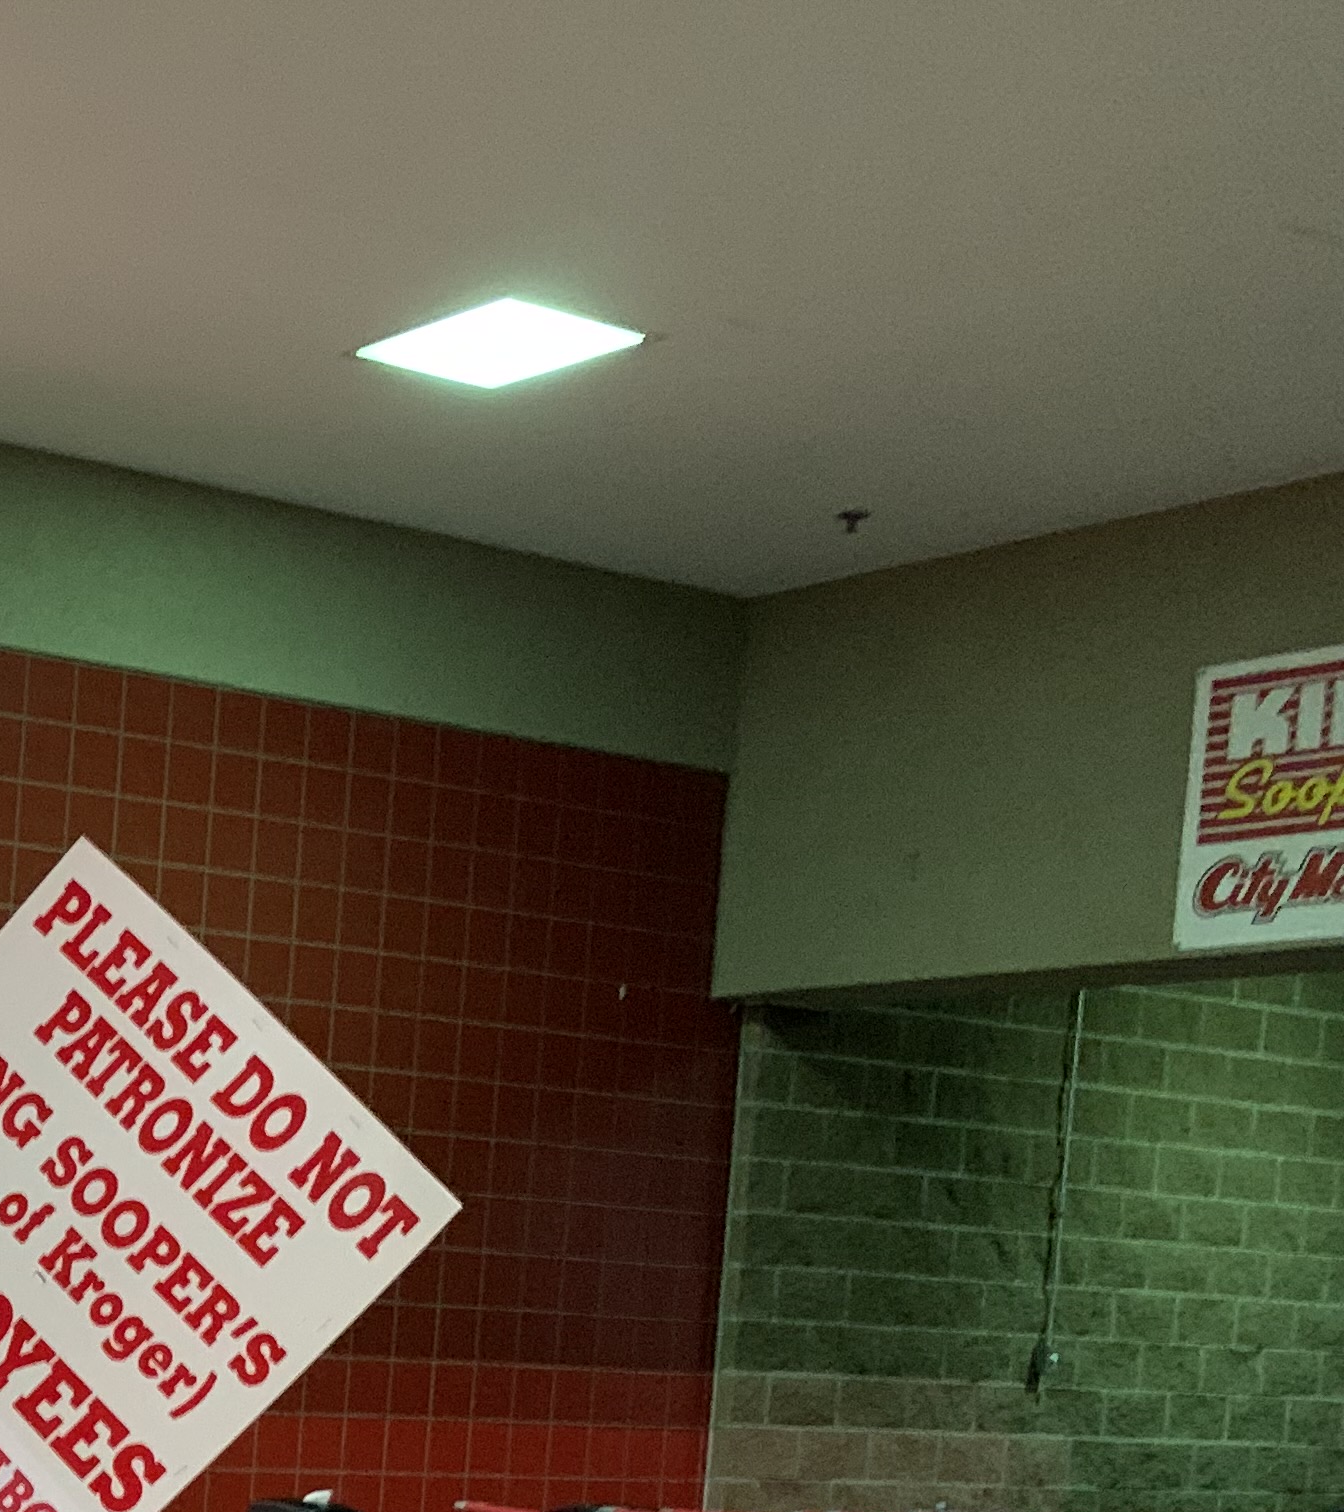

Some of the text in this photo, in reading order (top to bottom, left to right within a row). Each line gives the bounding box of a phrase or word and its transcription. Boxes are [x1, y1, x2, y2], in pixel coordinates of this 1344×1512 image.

[1196, 853, 1291, 921] City
[32, 879, 420, 1259] PLEASE DO NOT
[33, 988, 305, 1267] PATRONIZE
[38, 1226, 217, 1419] Kroger)
[39, 1135, 286, 1386] SOOPER'S
